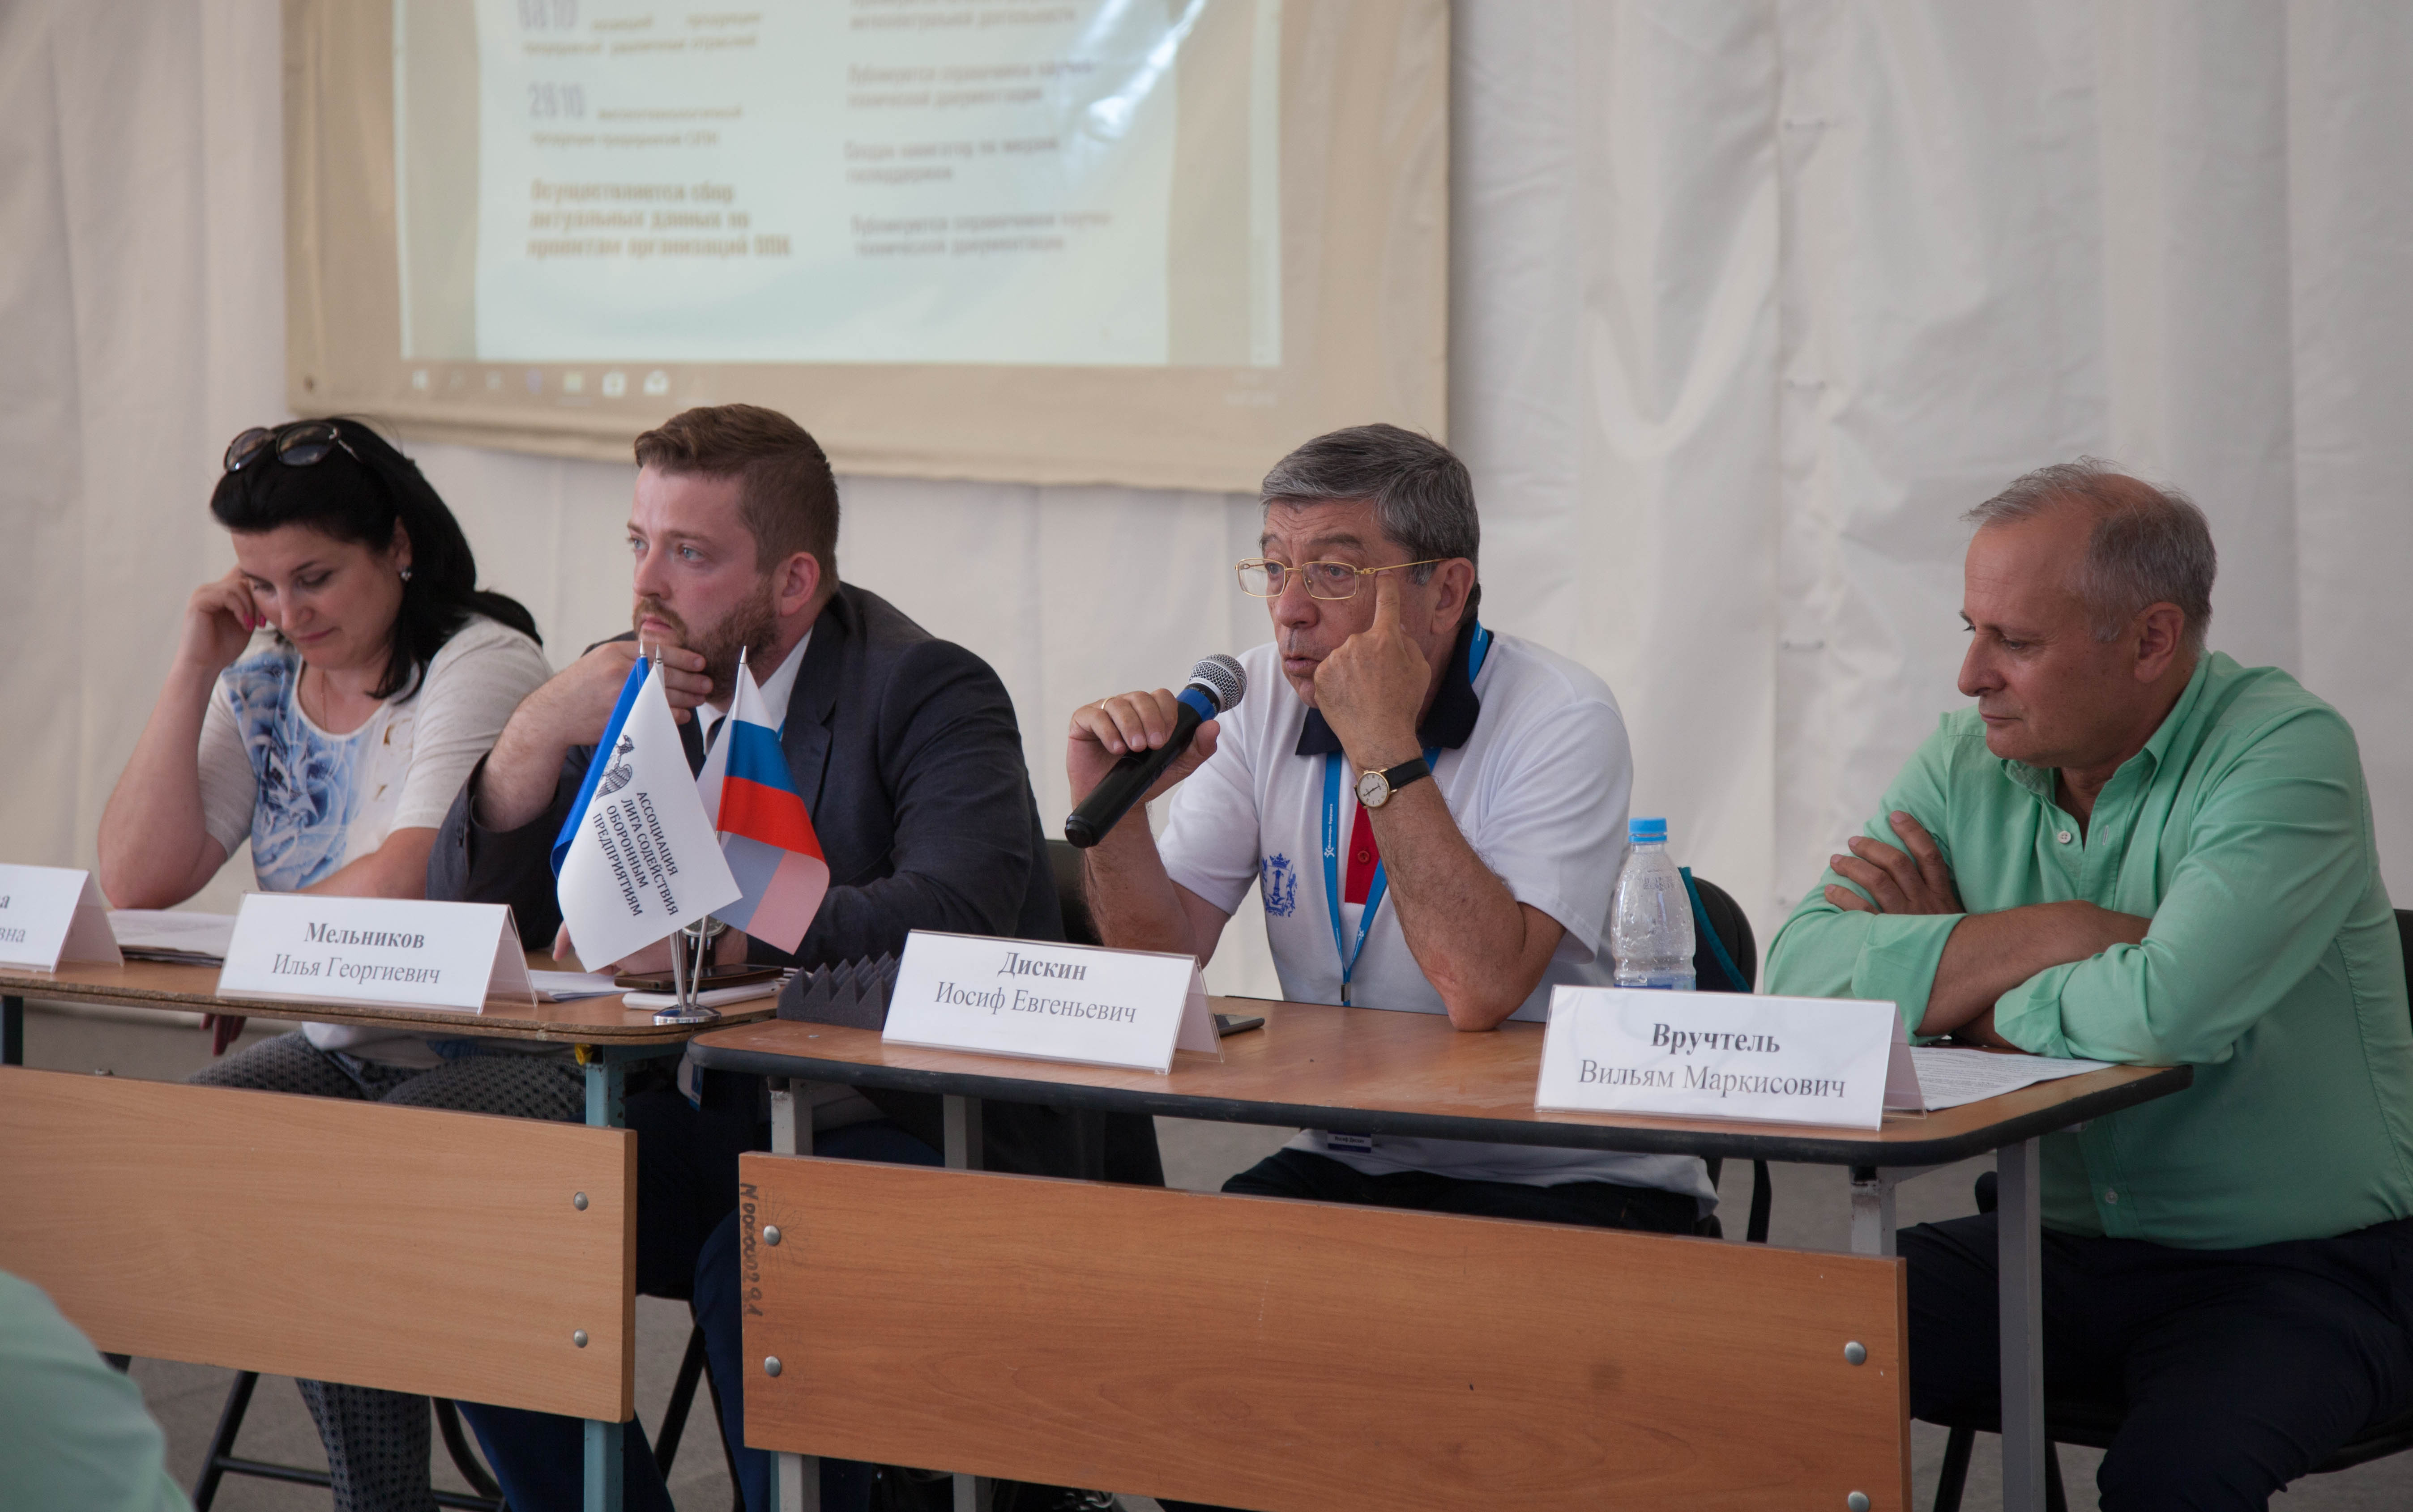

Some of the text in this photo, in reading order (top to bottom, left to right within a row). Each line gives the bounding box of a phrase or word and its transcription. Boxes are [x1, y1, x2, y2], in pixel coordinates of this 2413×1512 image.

[606, 805, 649, 889] ОБОРОННЫМ
[636, 792, 679, 877] АССОЦИАЦИЯ
[593, 812, 643, 917] ПРЕДПРИЯТИЯМ
[621, 799, 679, 916] ЛИГА СОДЕЙСТВИЯ
[0, 895, 10, 909] а
[304, 922, 425, 949] Мельников
[271, 954, 441, 985] Илья Георгиевич
[997, 952, 1087, 980] Дискин
[934, 981, 1137, 1023] Иосиф Евгеньевич
[1651, 1023, 1780, 1055] Вручтель
[1578, 1059, 1846, 1098] Вильям Маркисович
